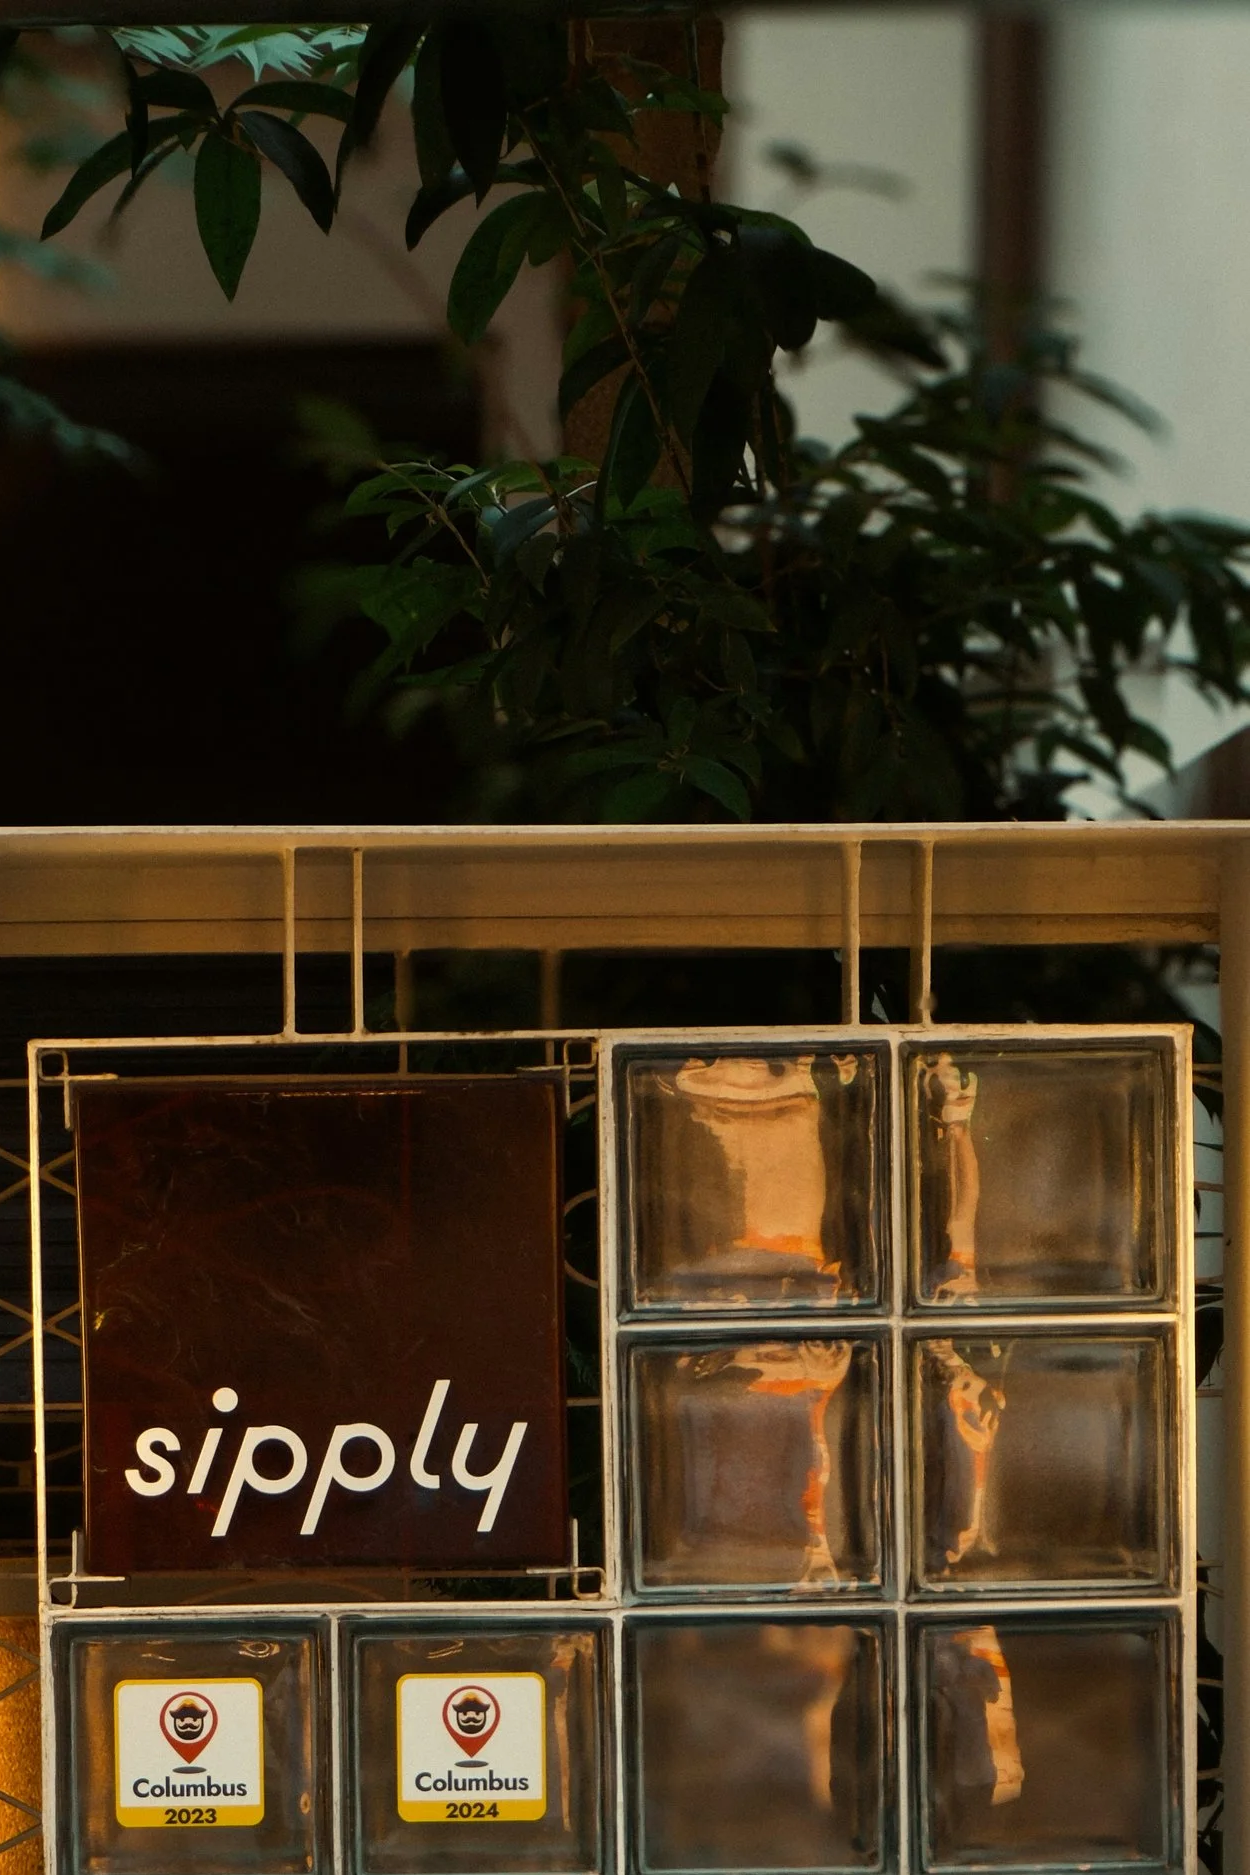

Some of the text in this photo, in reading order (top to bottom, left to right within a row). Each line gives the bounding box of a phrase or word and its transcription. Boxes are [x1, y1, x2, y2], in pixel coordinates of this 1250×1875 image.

[124, 1379, 528, 1537] sipply
[132, 1775, 248, 1799] Columbus
[414, 1769, 529, 1792] Columbus
[164, 1807, 218, 1825] 2023
[445, 1802, 500, 1819] 2024
